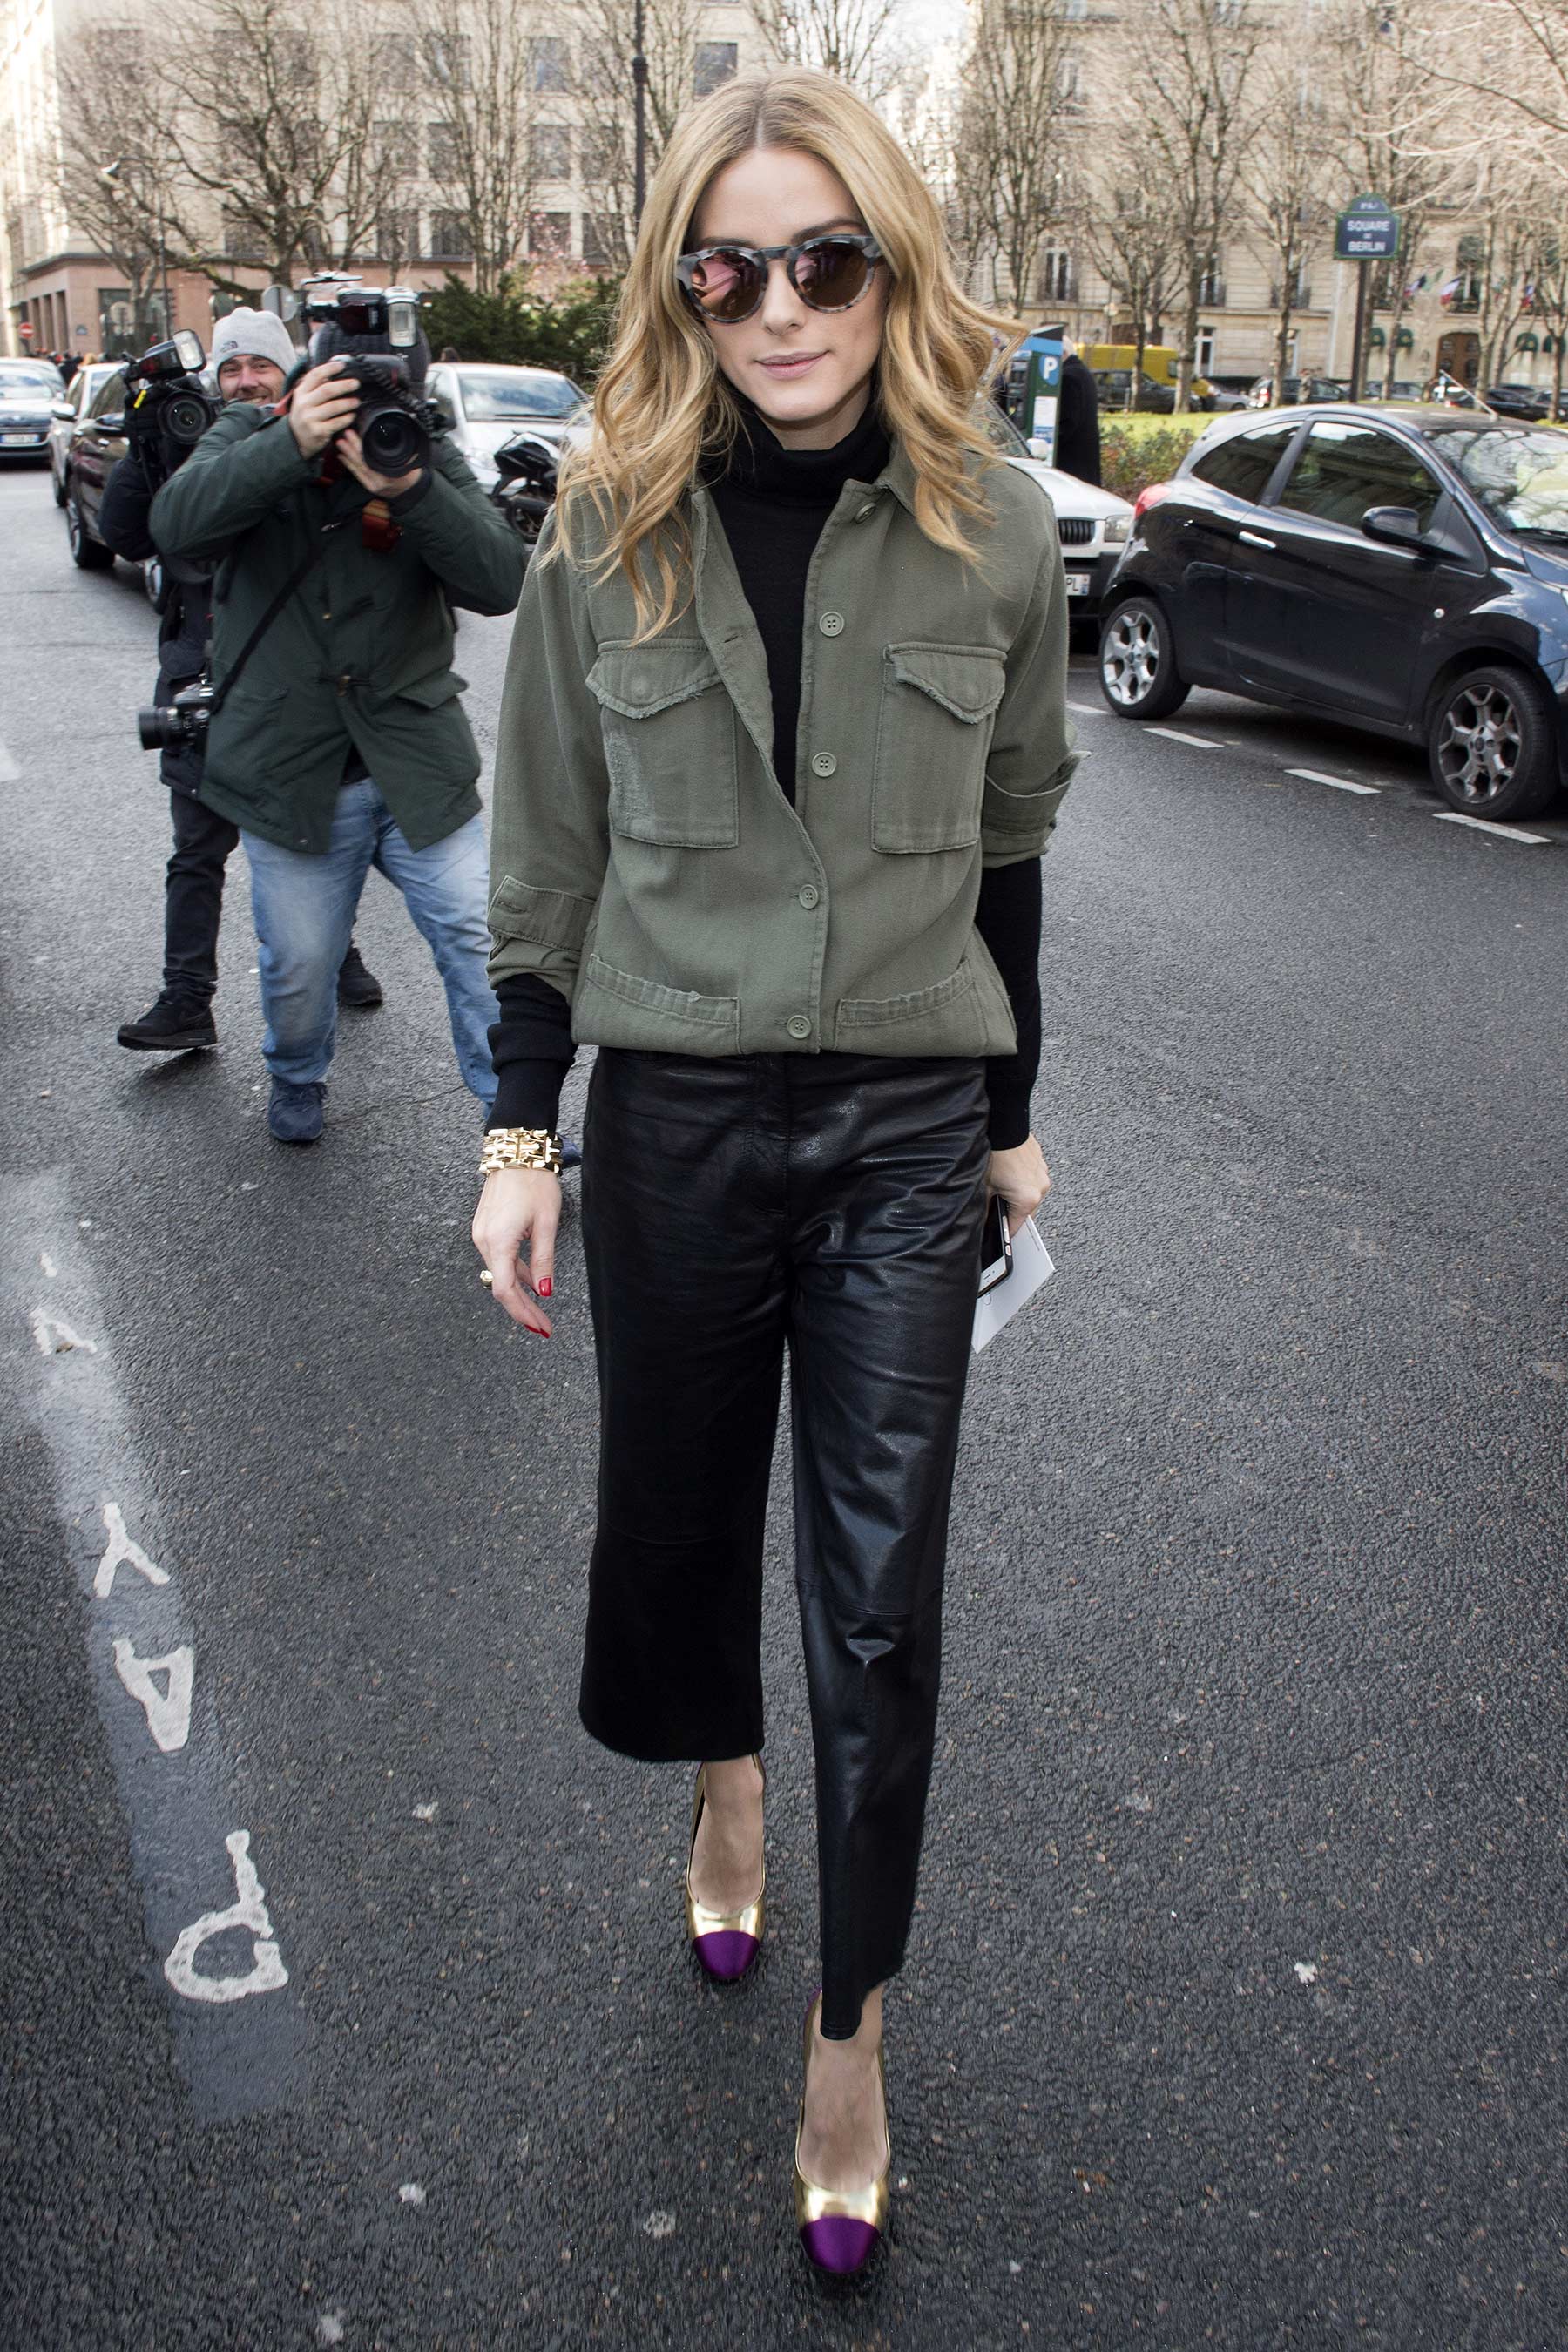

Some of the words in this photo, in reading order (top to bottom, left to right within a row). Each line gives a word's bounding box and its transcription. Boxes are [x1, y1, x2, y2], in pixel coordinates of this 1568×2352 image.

[1347, 220, 1389, 232] SQUARE
[1348, 241, 1386, 252] BERLIN
[1043, 356, 1058, 380] P
